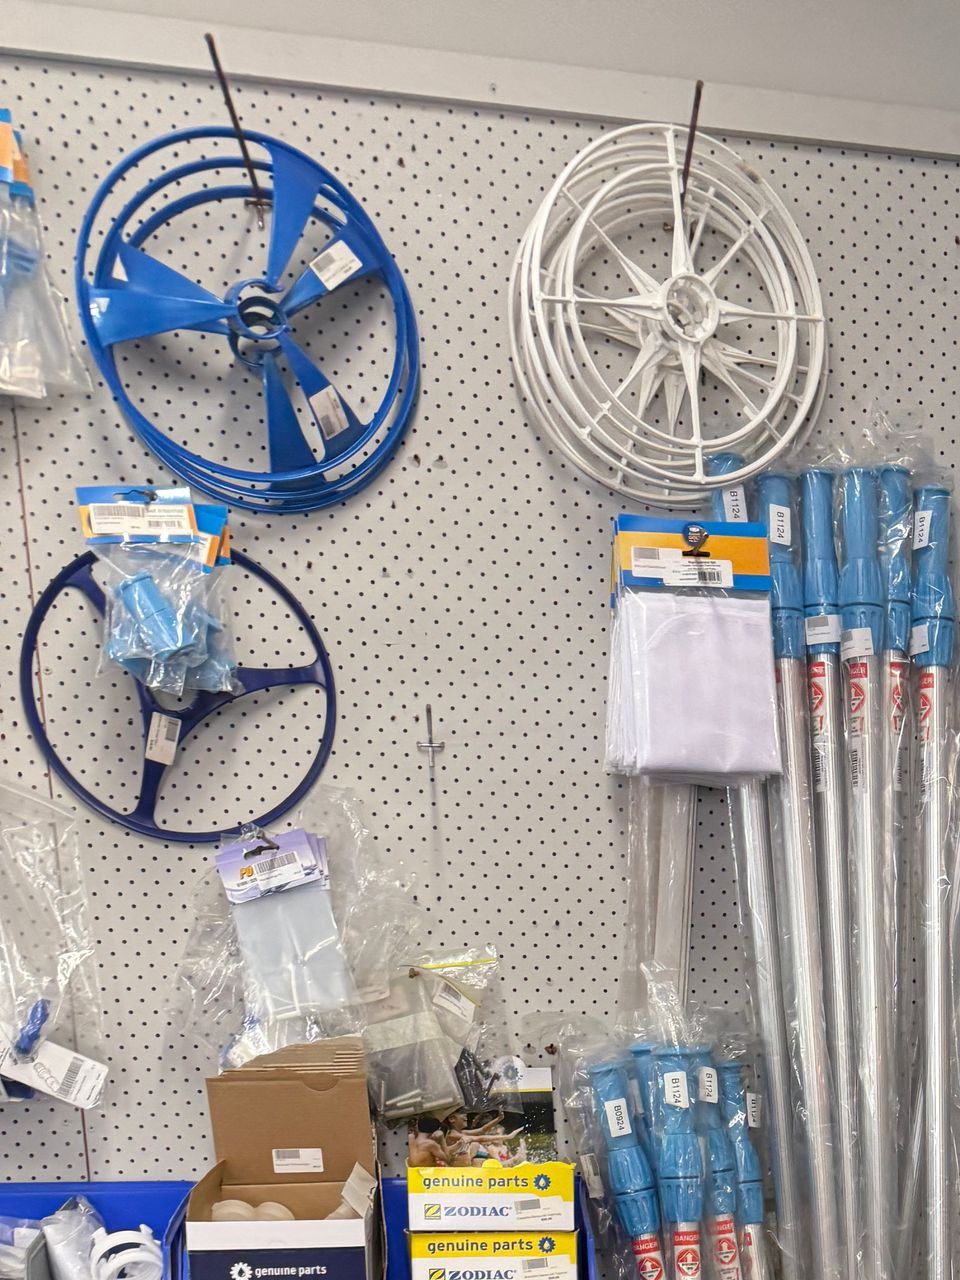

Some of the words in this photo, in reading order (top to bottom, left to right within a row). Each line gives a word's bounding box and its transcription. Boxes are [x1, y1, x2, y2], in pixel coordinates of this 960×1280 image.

[729, 489, 741, 520] B1124
[776, 511, 786, 540] B1124
[671, 1077, 681, 1106] B1124
[613, 1105, 626, 1132] B0924
[423, 1174, 483, 1189] genuine
[488, 1176, 529, 1189] parts
[443, 1206, 510, 1217] ZODIAC
[427, 1239, 488, 1254] genuine
[493, 1239, 533, 1253] parts
[254, 1267, 297, 1278] genuine
[298, 1265, 327, 1277] parts
[448, 1269, 515, 1280] ZODIAC
